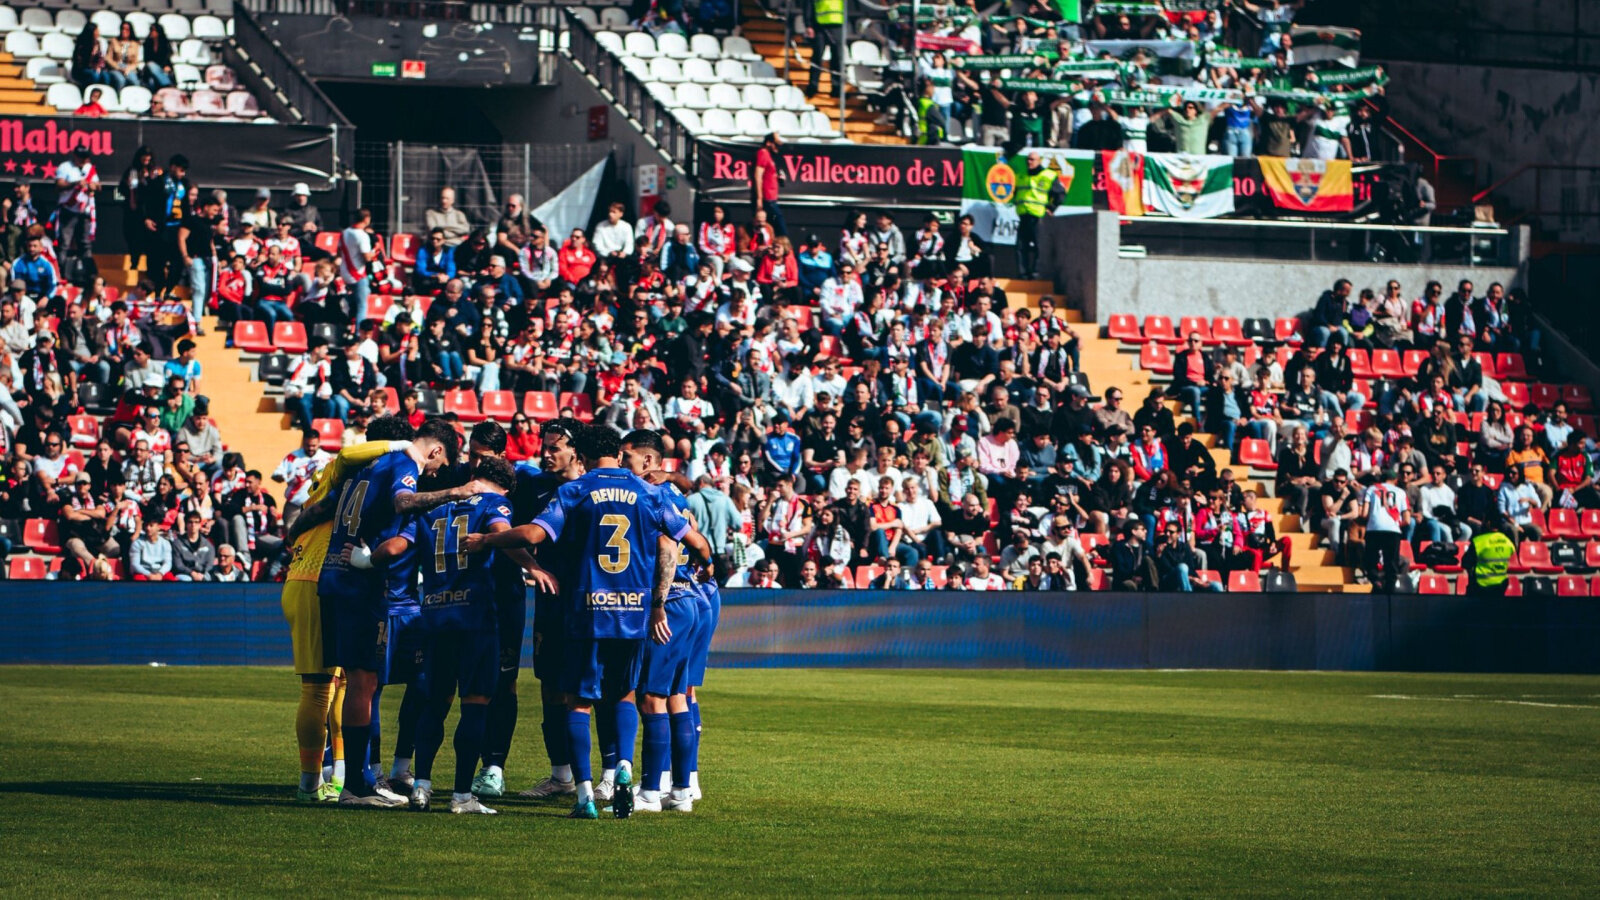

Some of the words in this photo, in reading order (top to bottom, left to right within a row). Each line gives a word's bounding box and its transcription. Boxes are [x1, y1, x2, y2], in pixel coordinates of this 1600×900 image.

[713, 151, 752, 188] Ra
[783, 155, 900, 185] Vallecano
[906, 159, 935, 187] de
[942, 159, 963, 187] M
[333, 479, 369, 536] 14
[590, 487, 638, 506] REVIVO
[1380, 489, 1396, 508] 10
[431, 514, 469, 574] 11
[598, 513, 631, 574] 3
